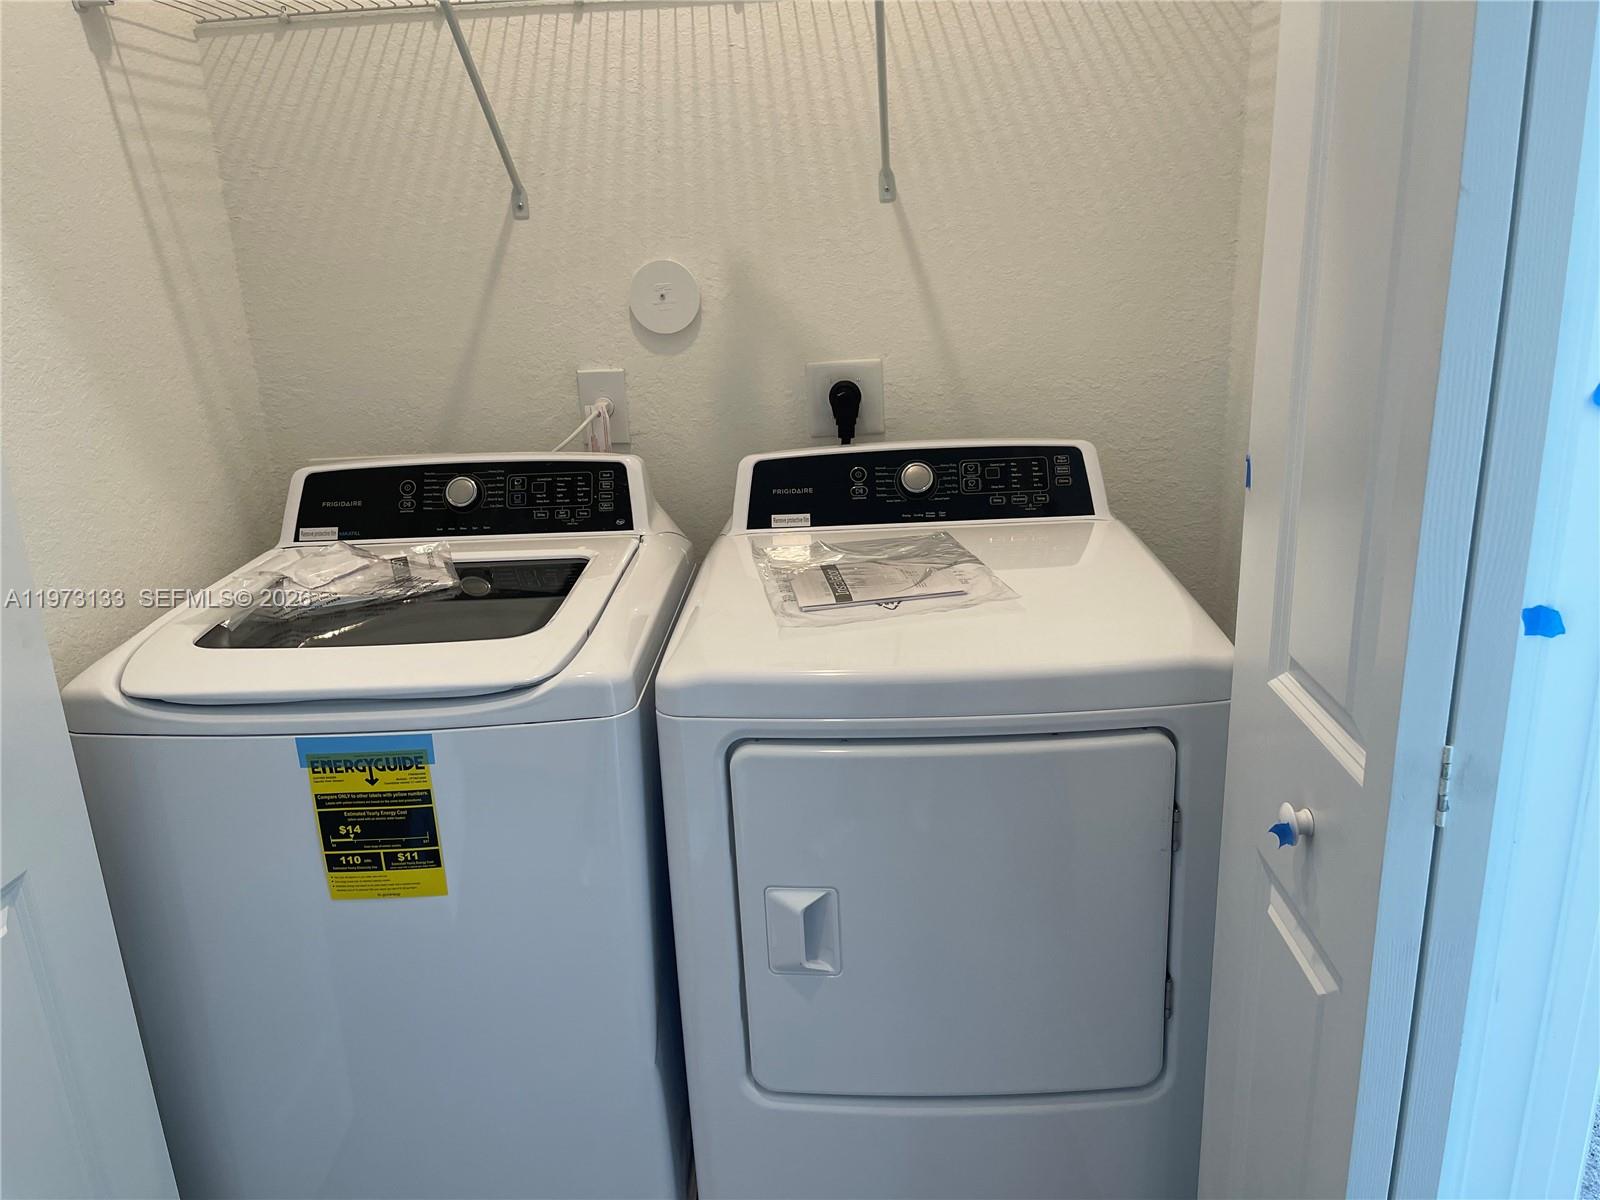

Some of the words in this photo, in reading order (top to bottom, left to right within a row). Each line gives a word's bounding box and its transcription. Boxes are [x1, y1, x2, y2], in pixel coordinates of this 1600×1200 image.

[310, 756, 425, 776] ENERGYGUIDE
[339, 825, 362, 834] $14
[340, 856, 361, 864] 110
[398, 852, 419, 861] $11
